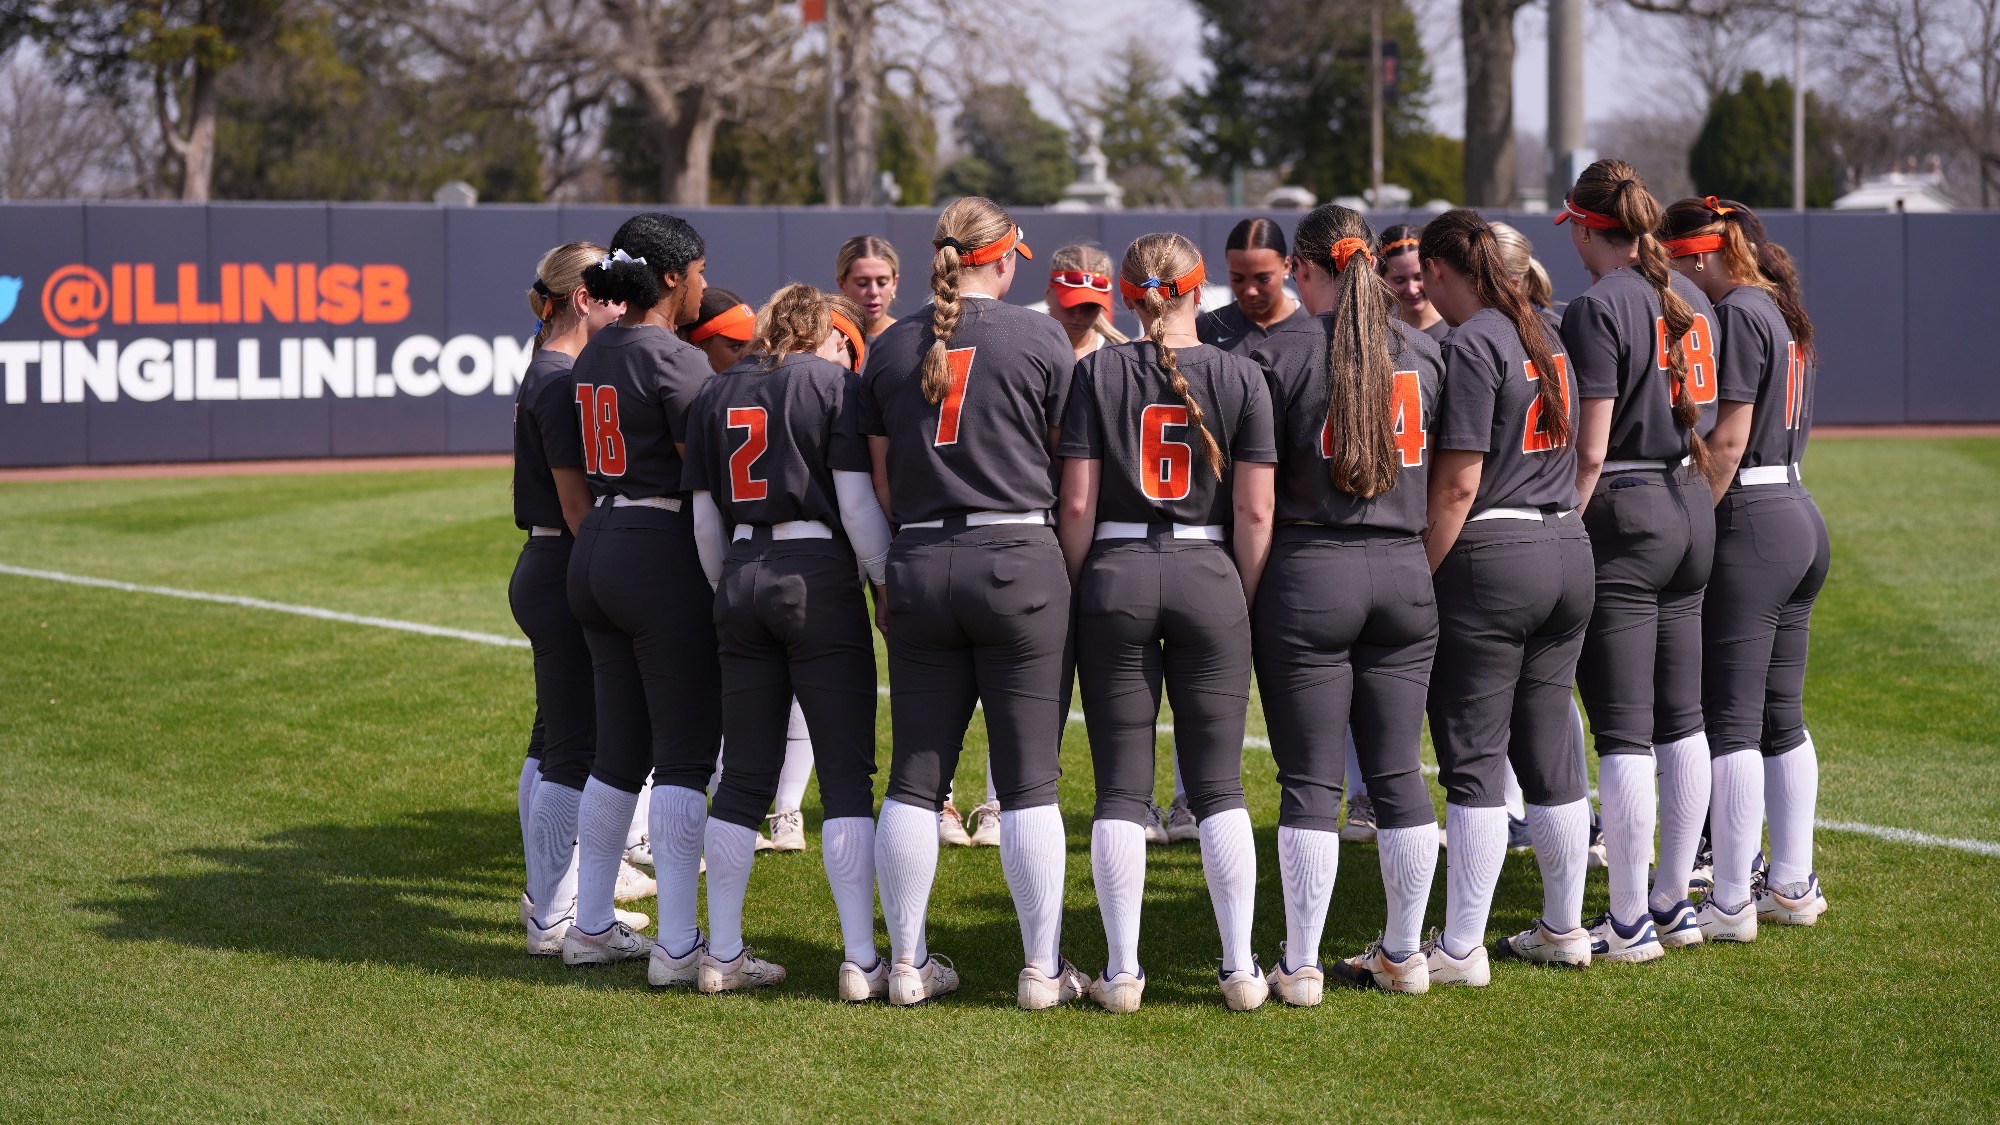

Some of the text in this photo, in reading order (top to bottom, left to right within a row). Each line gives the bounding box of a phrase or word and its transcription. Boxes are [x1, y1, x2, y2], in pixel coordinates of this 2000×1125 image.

[41, 262, 411, 338] @ILLINISB
[575, 383, 627, 477] 18
[726, 406, 768, 502] 2
[1139, 403, 1192, 501] 6
